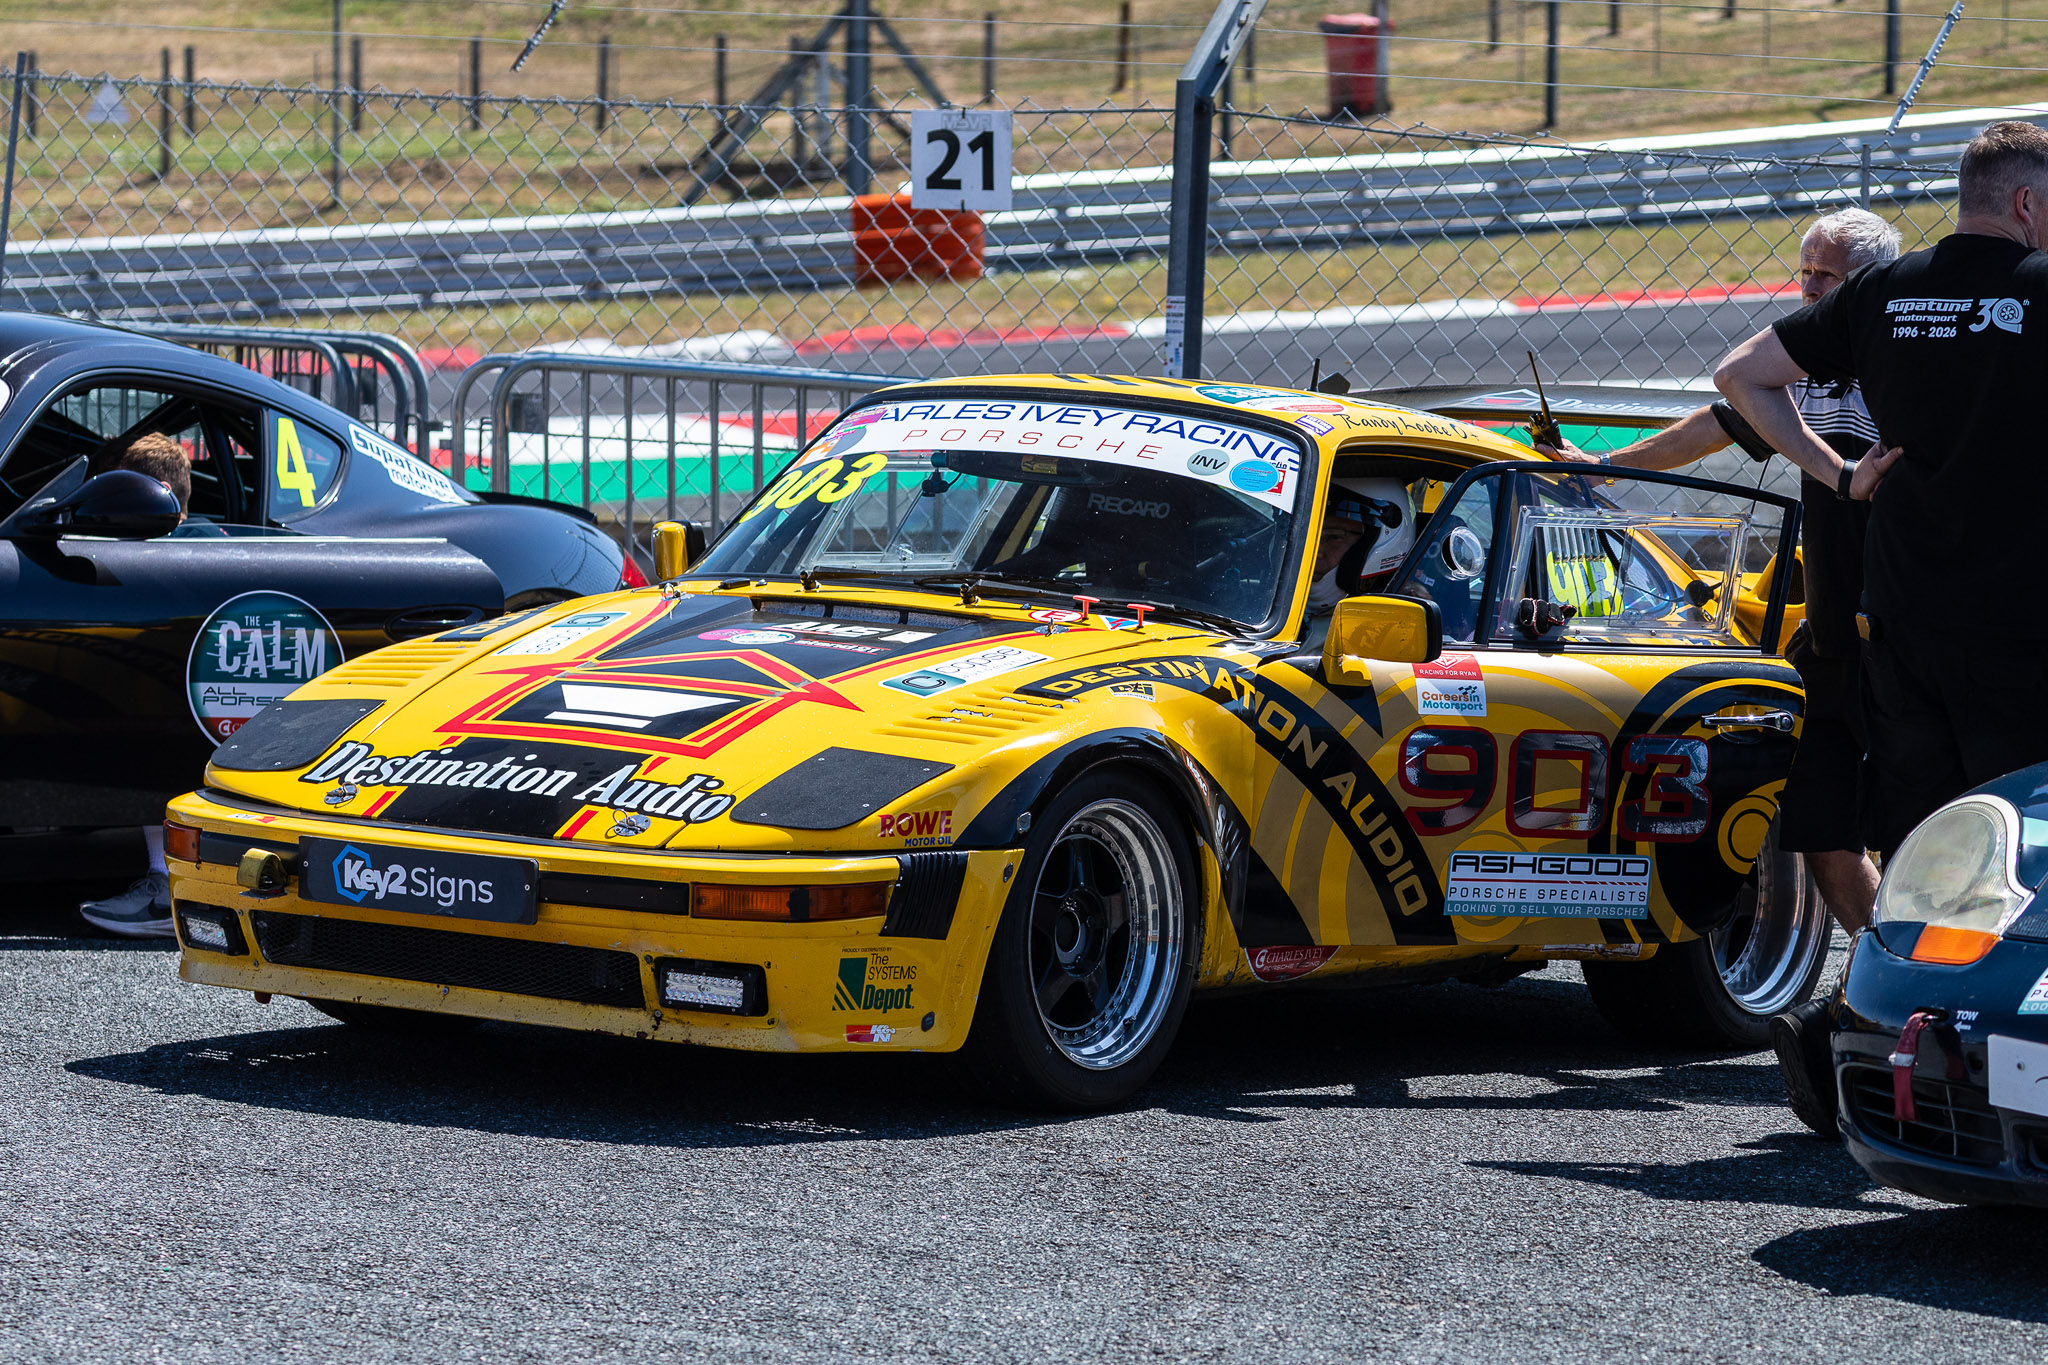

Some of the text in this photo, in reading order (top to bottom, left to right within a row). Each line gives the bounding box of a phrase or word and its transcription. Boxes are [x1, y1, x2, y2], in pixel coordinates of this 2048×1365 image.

[926, 129, 994, 190] 21
[1894, 314, 1958, 324] motorsport
[1892, 327, 1918, 338] 1996
[1928, 326, 1957, 338] 2026
[1553, 398, 1697, 415] Destinati
[881, 403, 1011, 422] ARLES
[1020, 405, 1111, 427] IVEY
[1122, 413, 1299, 471] RACING
[902, 428, 1164, 460] PORSCHE
[276, 417, 317, 507] 4
[1191, 454, 1227, 470] INV
[739, 454, 888, 523] 903
[1087, 493, 1171, 519] RECARO
[244, 615, 261, 627] THE
[771, 621, 893, 638] AMS
[208, 620, 326, 679] CALM
[203, 686, 247, 696] ALL
[1422, 700, 1483, 712] Motorsport
[303, 742, 733, 821] Destination Audio
[1041, 657, 1328, 769] DESTINATION
[1322, 771, 1428, 916] AUDIO
[1397, 725, 1712, 843] 903
[877, 810, 953, 838] ROWE
[904, 836, 953, 847] MOTOR OIL
[1451, 855, 1649, 876] ASHGOOD
[1449, 887, 1646, 902] PORSCHE SPECIALISTS
[1447, 903, 1645, 917] LOOKING TO SELL YOUR PORSCHE?
[870, 953, 889, 965] The
[1266, 947, 1324, 964] CHARLES IVEY
[868, 965, 917, 981] SYSTEMS
[1956, 1010, 1979, 1020] TOW
